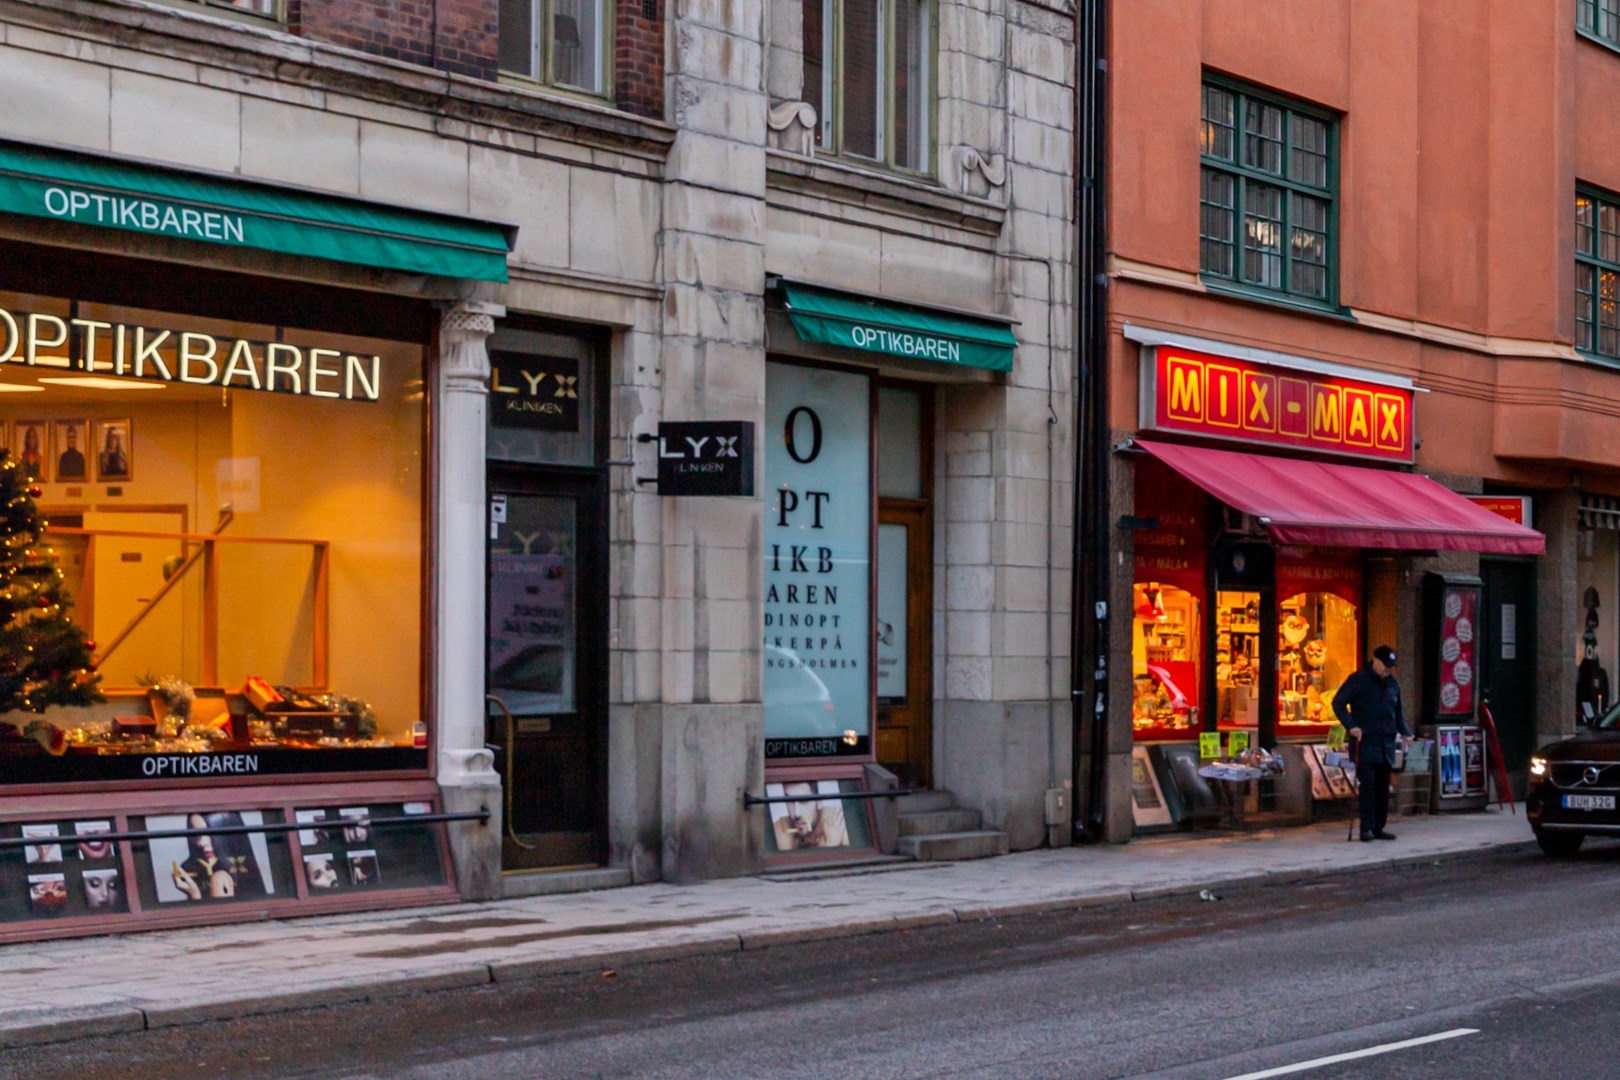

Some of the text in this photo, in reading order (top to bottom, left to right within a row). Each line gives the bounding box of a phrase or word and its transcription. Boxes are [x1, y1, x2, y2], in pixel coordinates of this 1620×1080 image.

[44, 188, 244, 243] OPTIKBAREN
[852, 325, 960, 362] OPTIKBAREN
[492, 367, 577, 398] LYX
[506, 400, 562, 414] KLINIKEN
[1170, 365, 1400, 444] MIX-MAX
[660, 436, 738, 458] LYX
[784, 406, 823, 464] O
[777, 488, 830, 529] PT
[772, 544, 834, 573] IKB
[767, 584, 837, 604] AREN
[765, 613, 841, 628] DINOPT
[766, 740, 837, 756] OPTIKBAREN
[142, 754, 258, 776] OPTIKBAREN
[1569, 796, 1590, 808] BUH
